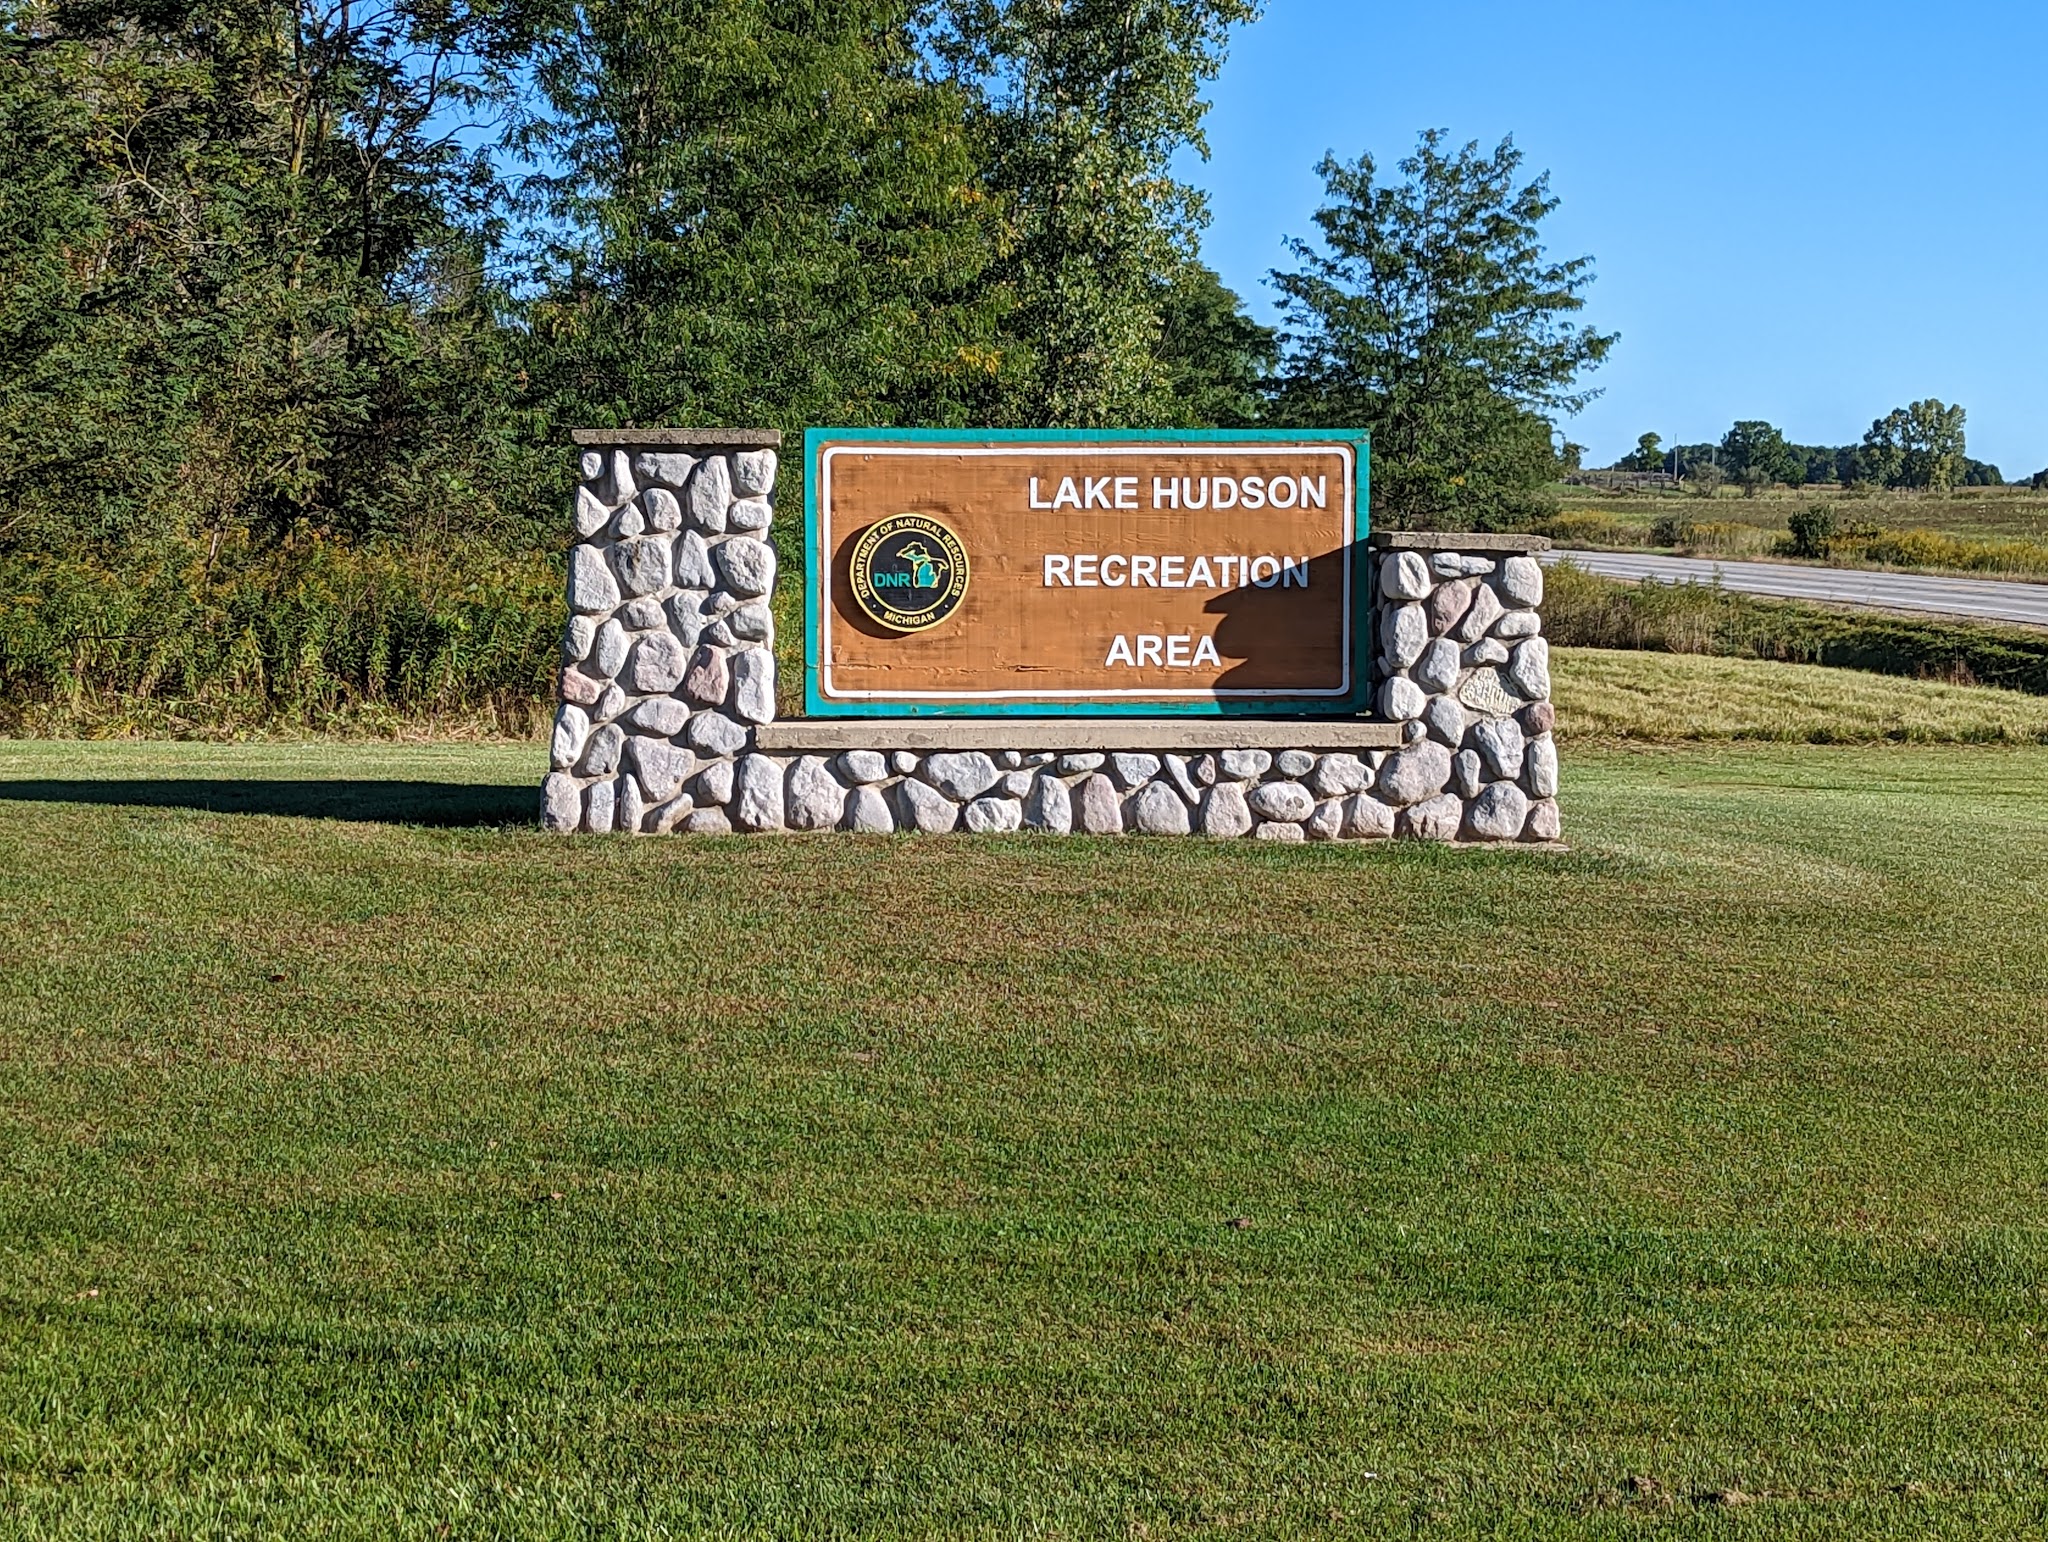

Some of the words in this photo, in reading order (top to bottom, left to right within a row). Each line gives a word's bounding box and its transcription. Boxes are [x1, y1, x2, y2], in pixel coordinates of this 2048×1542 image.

[1029, 476, 1139, 509] LAKE
[1152, 475, 1327, 509] HUDSON
[856, 533, 880, 598] DEPARTMENT
[880, 523, 893, 534] OF
[896, 518, 942, 537] NATURAL
[942, 535, 965, 597] RESOURCES
[1044, 554, 1309, 588] RECREATION
[873, 573, 911, 587] DNR
[883, 611, 935, 625] MICHIGAN
[1105, 634, 1221, 667] AREA
